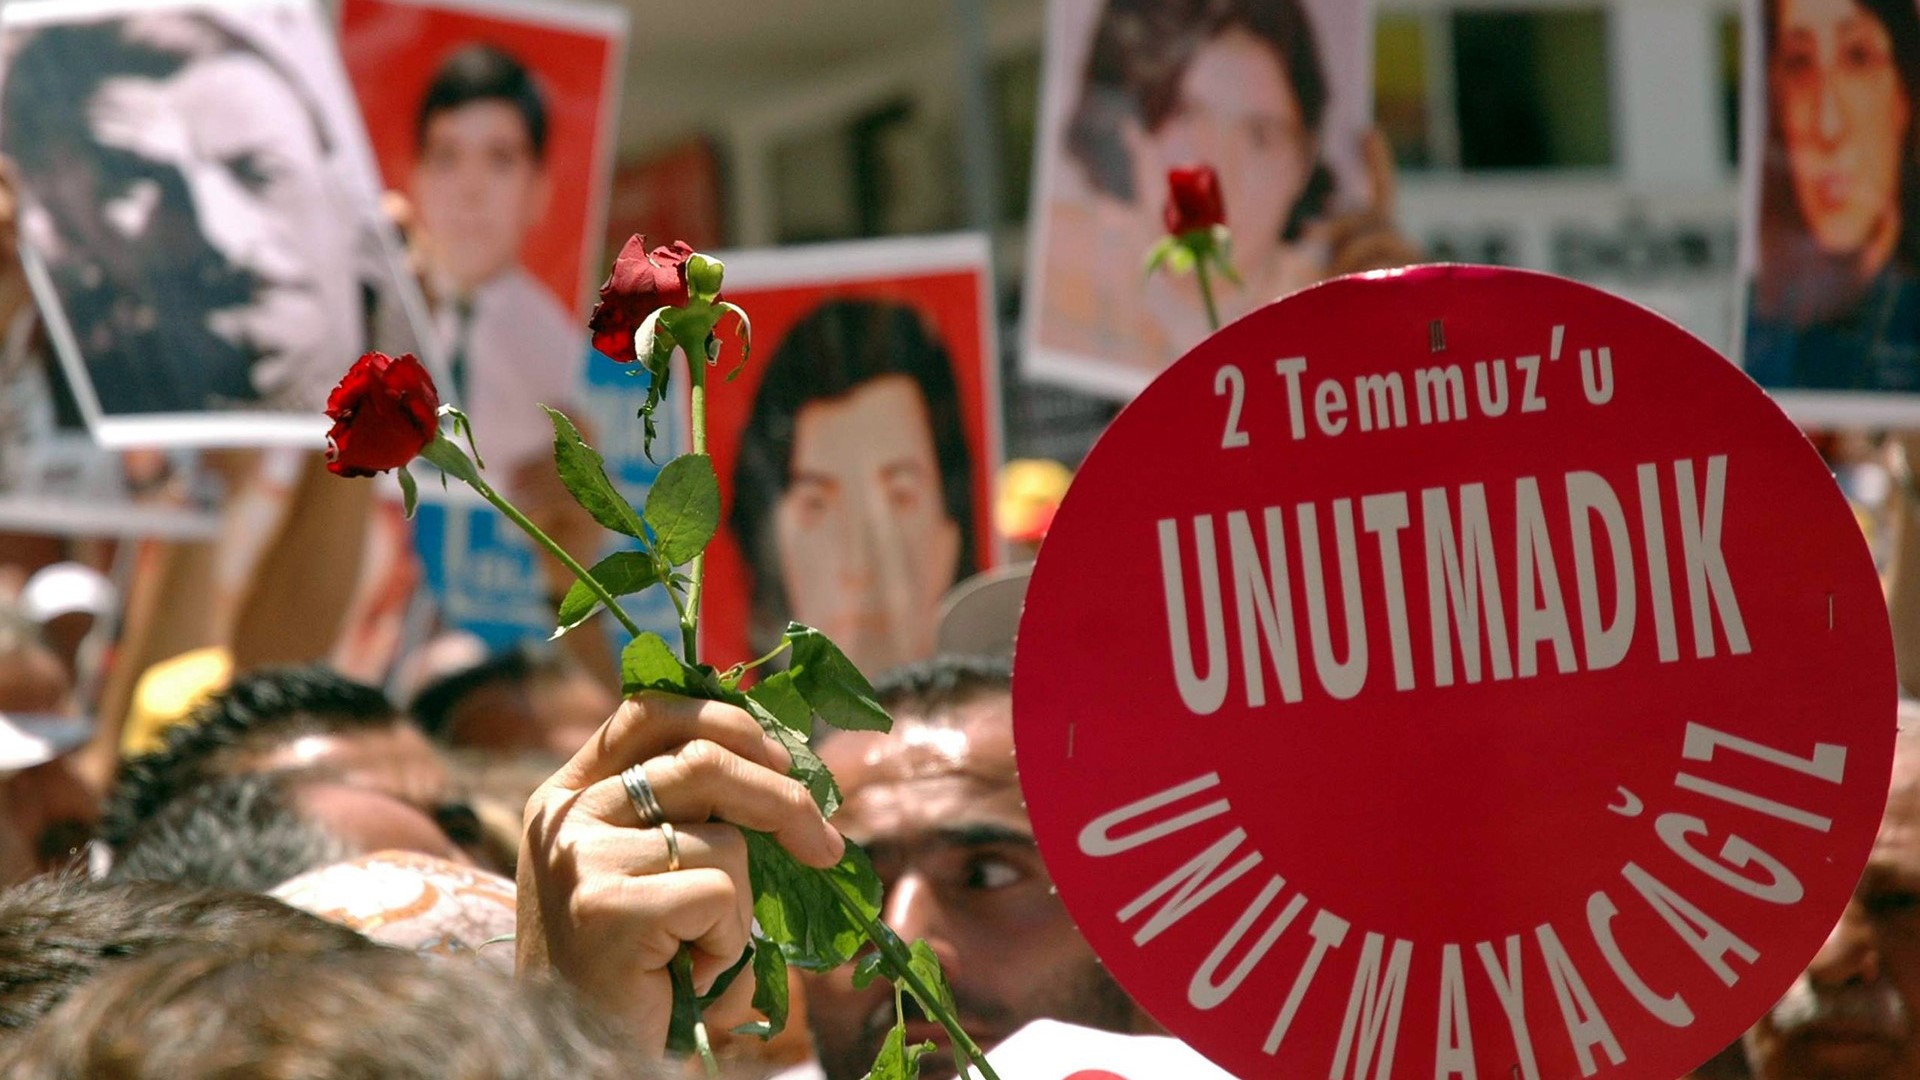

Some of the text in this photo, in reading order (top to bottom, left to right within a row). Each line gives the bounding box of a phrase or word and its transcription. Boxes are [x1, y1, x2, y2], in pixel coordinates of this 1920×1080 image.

[1214, 325, 1615, 449] 2 Temmuz'u
[1158, 455, 1751, 715] UNUTMADIK
[1078, 722, 1847, 1080] UNUTMAYACAĞIZ
